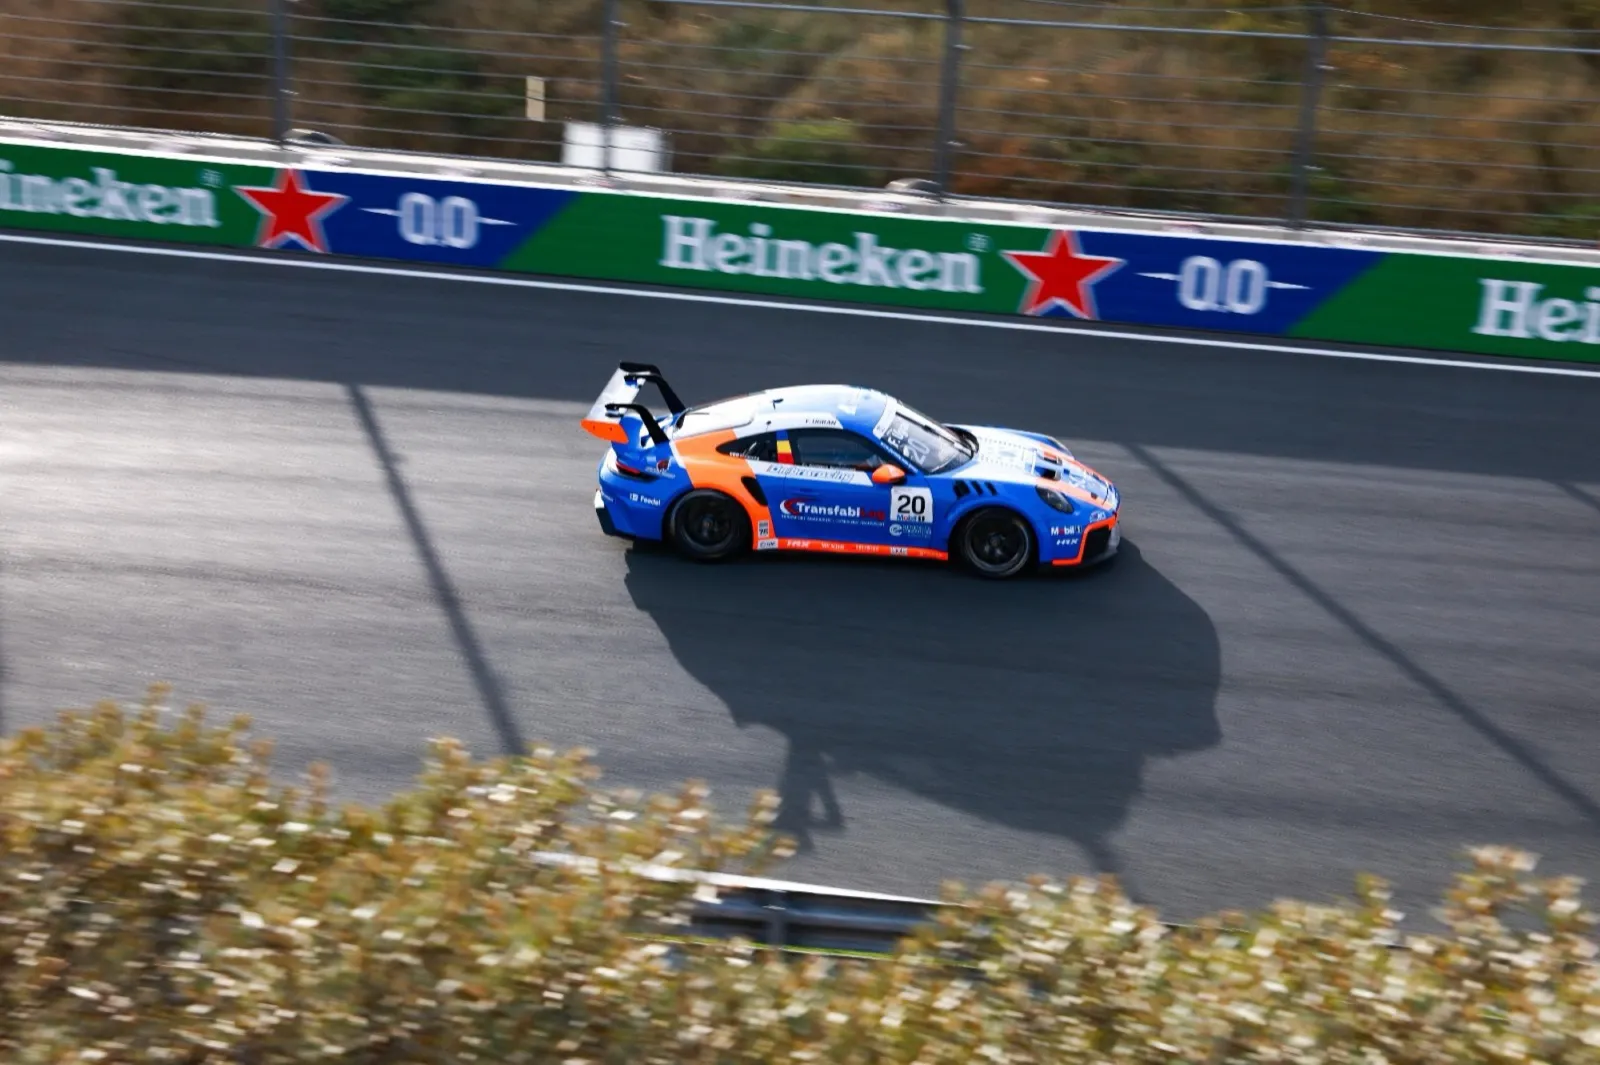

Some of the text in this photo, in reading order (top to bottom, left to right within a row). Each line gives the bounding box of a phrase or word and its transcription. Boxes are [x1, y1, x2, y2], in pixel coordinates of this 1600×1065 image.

[659, 214, 985, 294] Heineken
[897, 494, 926, 515] 20
[1050, 525, 1075, 536] Mobil
